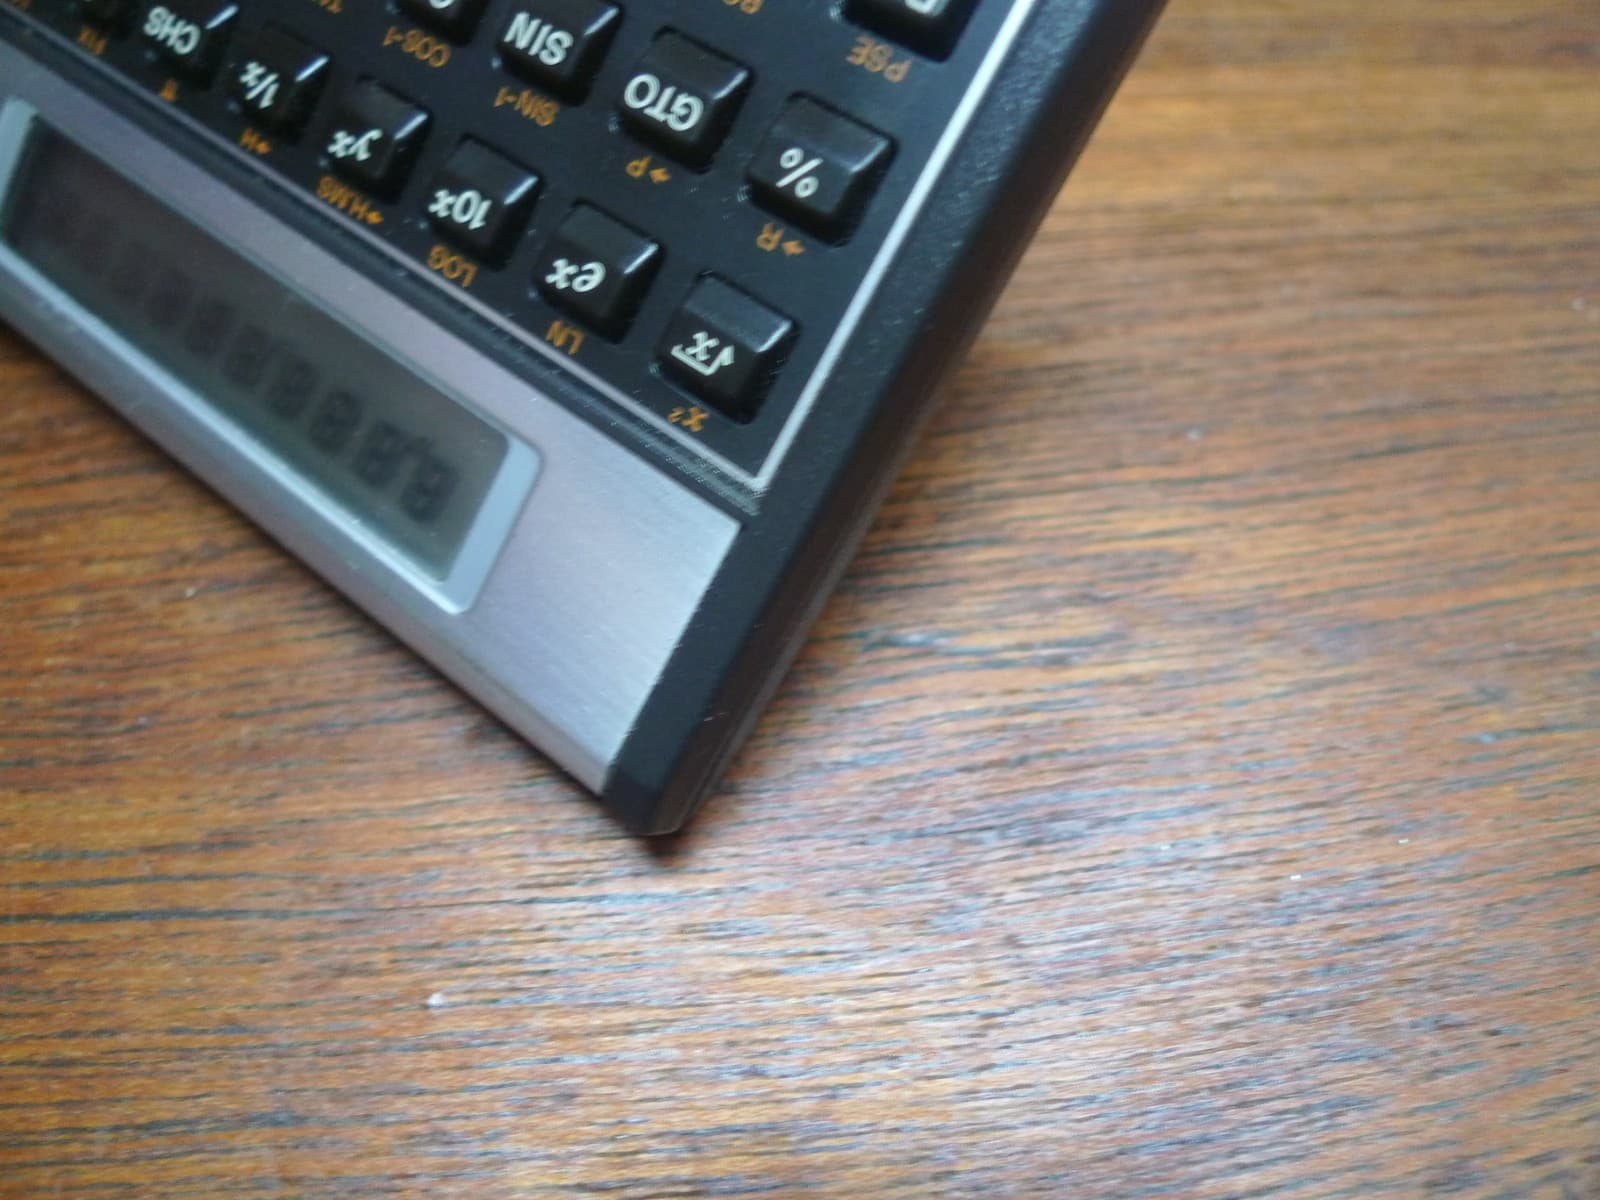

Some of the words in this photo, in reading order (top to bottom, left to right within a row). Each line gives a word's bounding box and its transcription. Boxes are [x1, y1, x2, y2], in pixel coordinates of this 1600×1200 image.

[143, 6, 200, 55] CHS
[503, 11, 574, 66] SIN
[846, 36, 912, 83] PSE
[623, 73, 704, 132] GTO
[776, 147, 824, 199] %
[427, 245, 478, 288] LOG
[546, 320, 584, 355] LN
